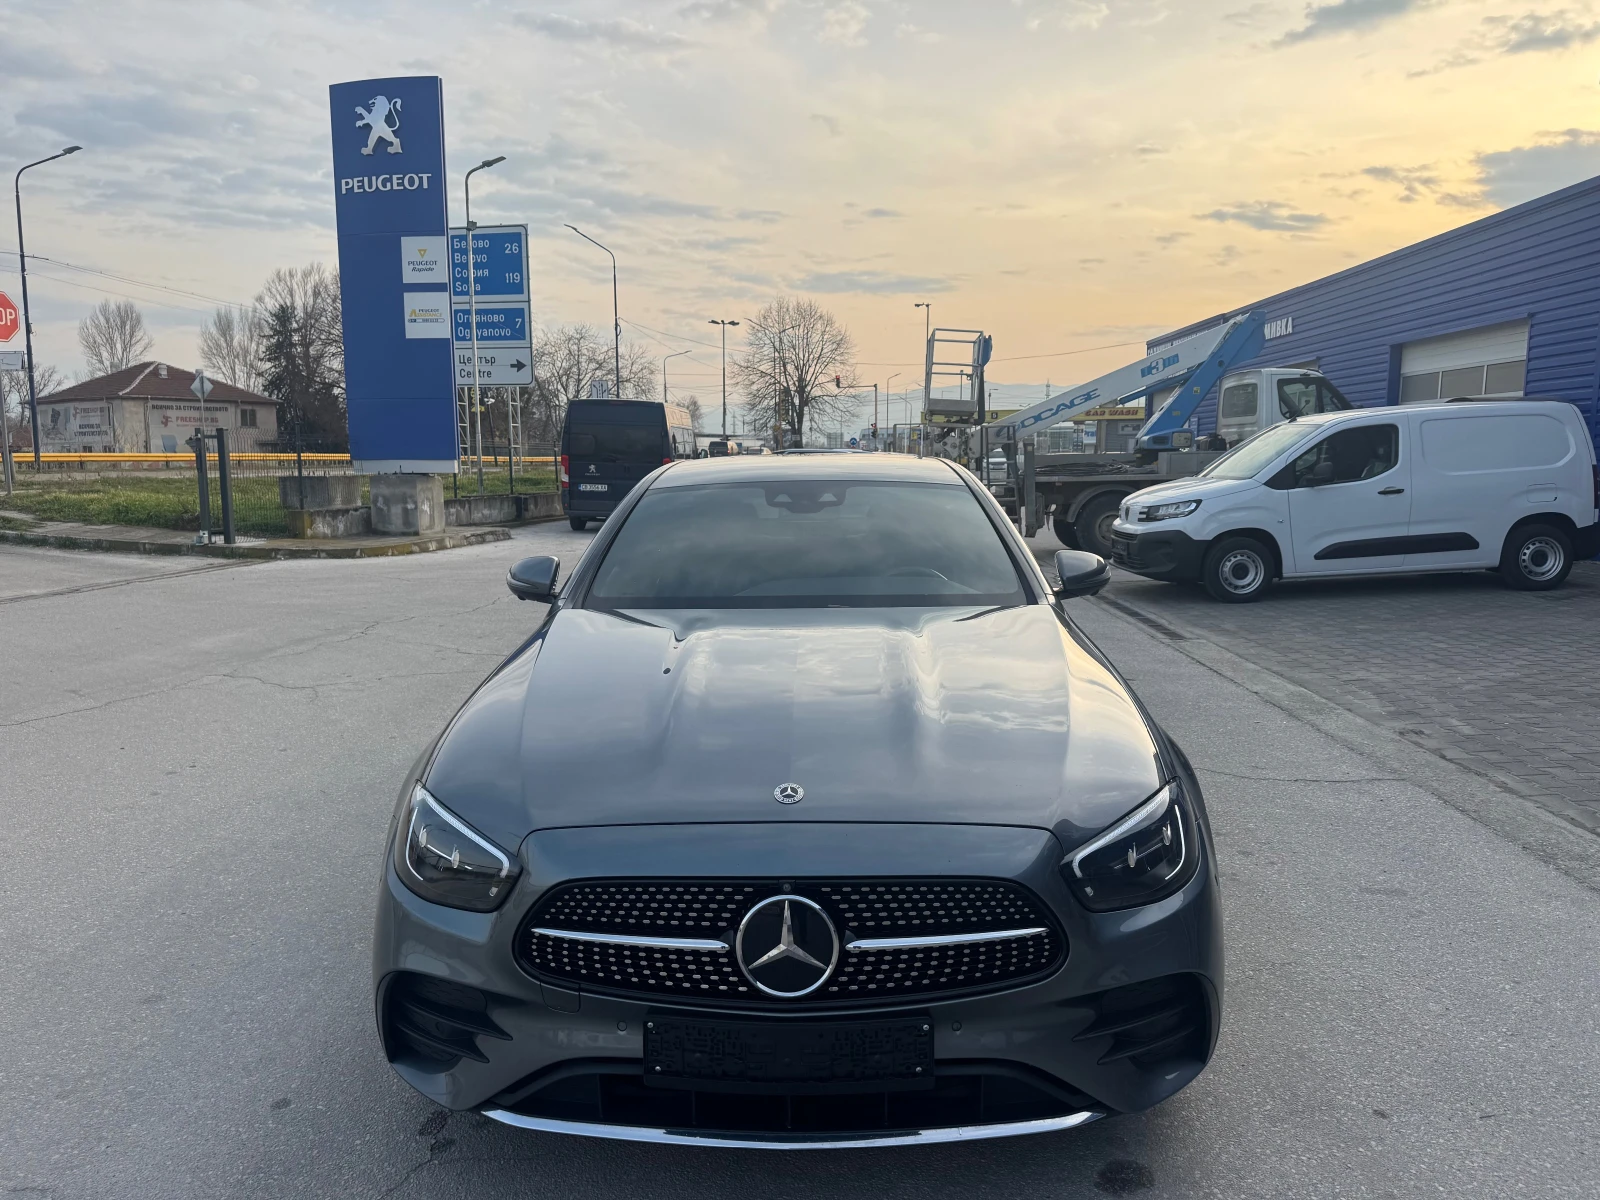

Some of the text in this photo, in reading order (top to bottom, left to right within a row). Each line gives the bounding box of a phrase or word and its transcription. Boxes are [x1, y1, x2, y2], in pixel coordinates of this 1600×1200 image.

[341, 173, 432, 195] PEUGEOT
[453, 238, 490, 249] Беово
[504, 243, 519, 254] 26
[454, 252, 488, 263] Beovo
[505, 272, 520, 283] 119
[455, 281, 481, 291] Soa
[457, 312, 505, 323] Огяново
[515, 318, 522, 329] 7
[457, 326, 511, 340] Ogyanovo
[458, 354, 496, 366] Цетър
[459, 368, 492, 379] Cetre
